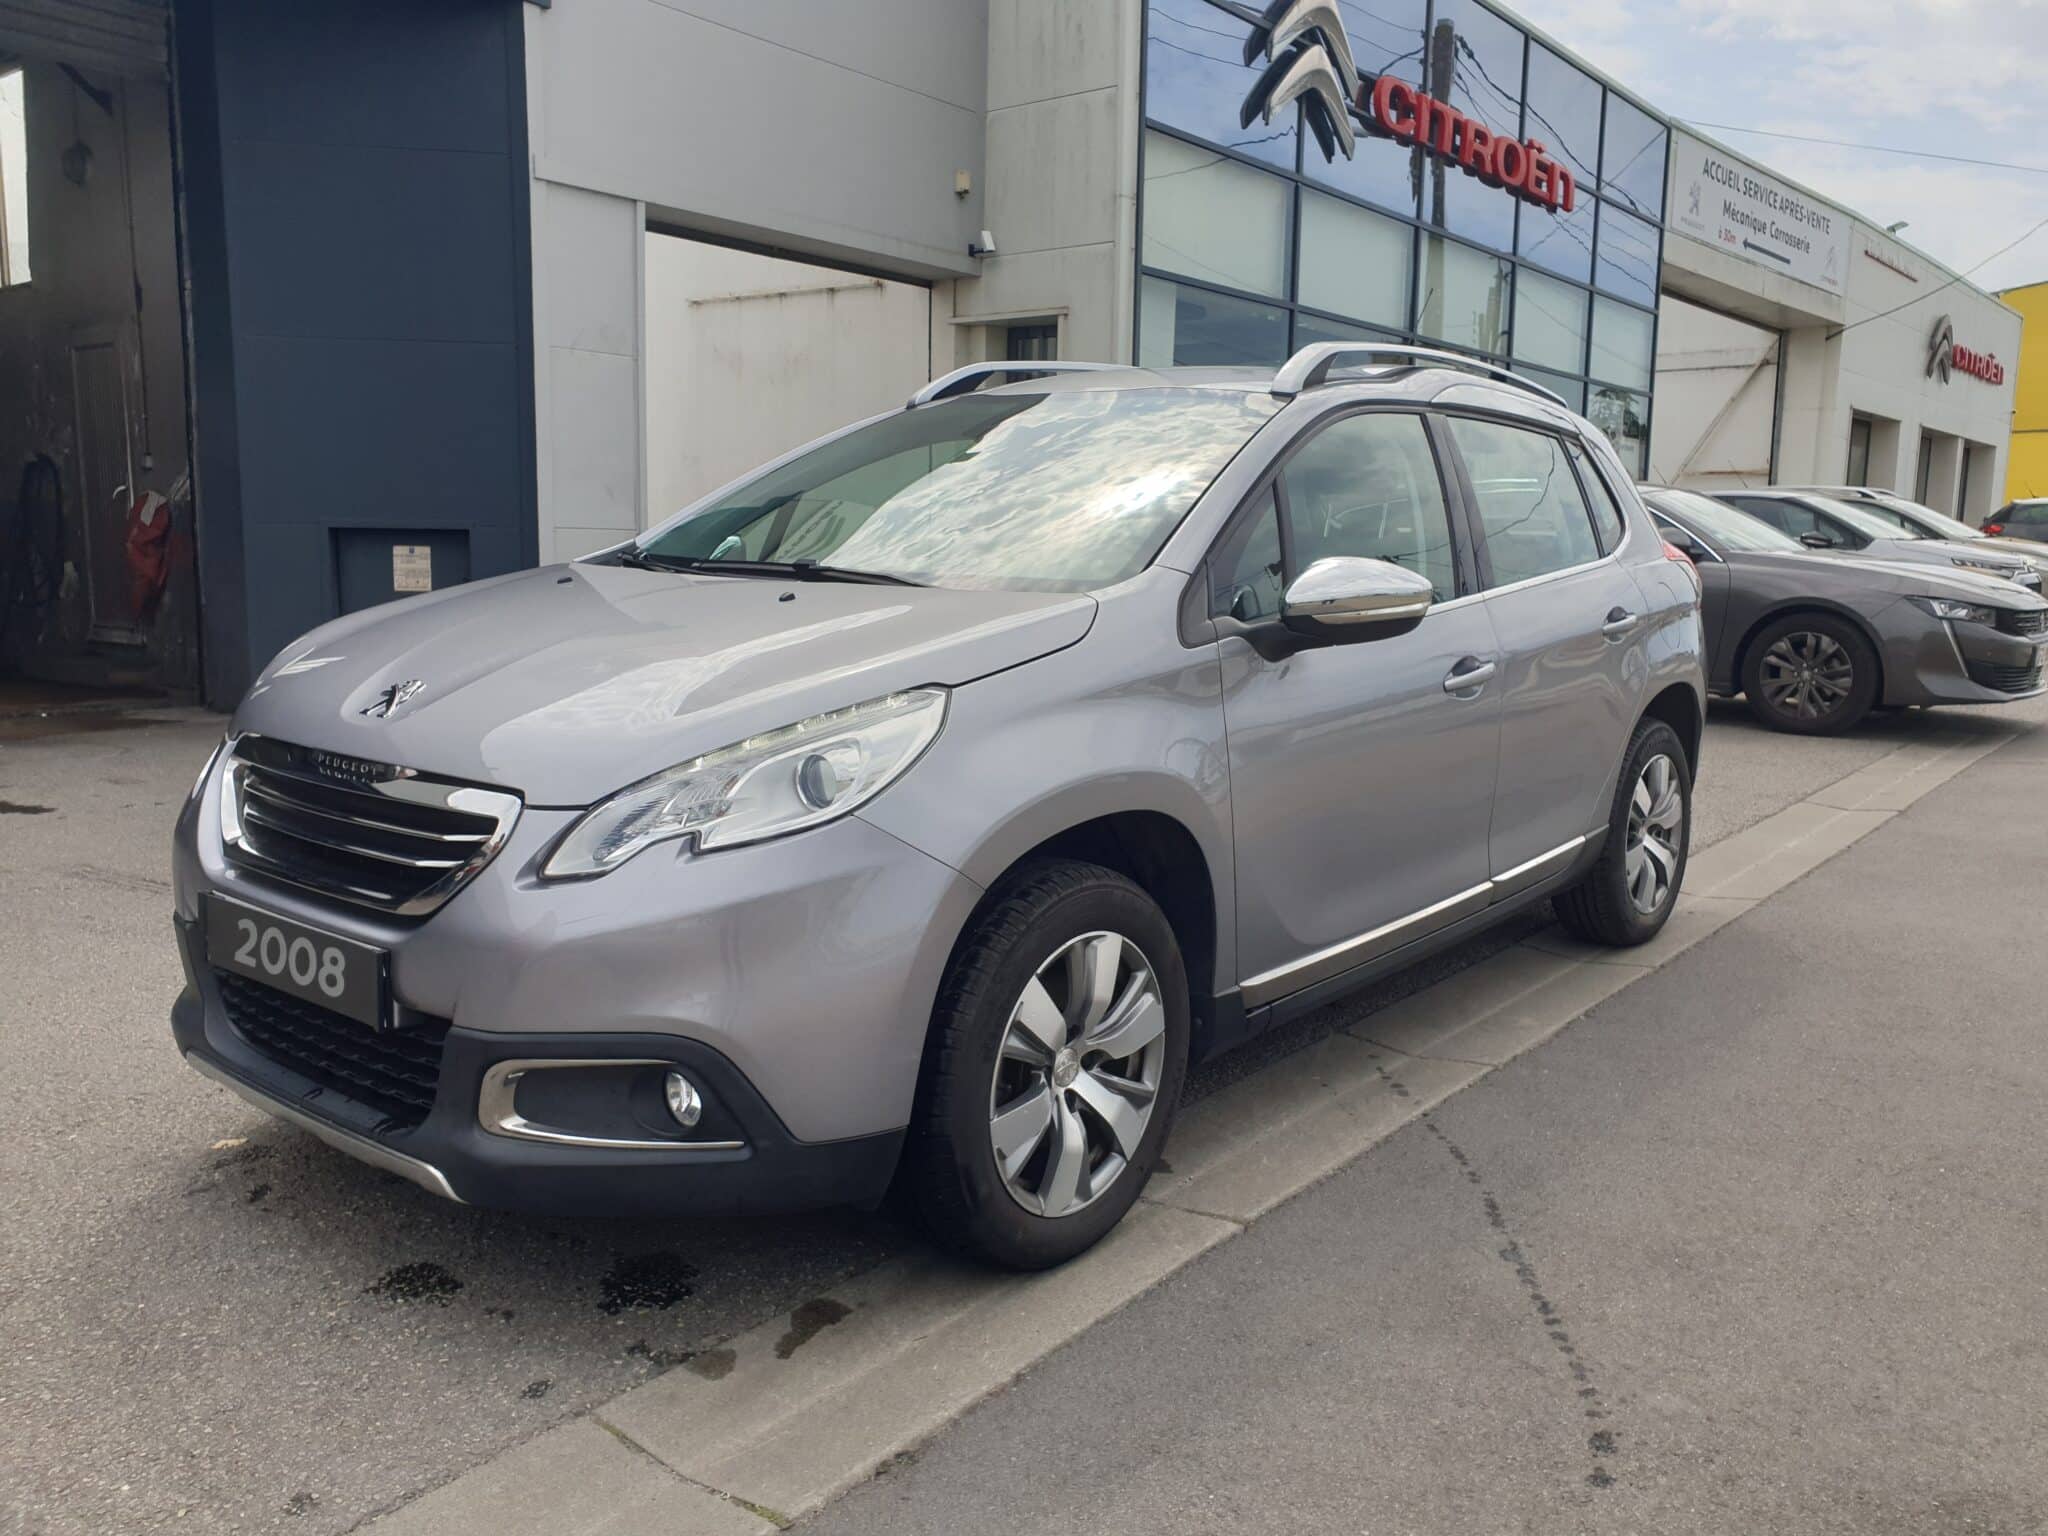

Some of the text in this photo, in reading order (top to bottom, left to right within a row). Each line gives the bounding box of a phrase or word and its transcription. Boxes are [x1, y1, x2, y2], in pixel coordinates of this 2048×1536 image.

[1703, 157, 1832, 236] ACCUEIL SERVICE APRÈS-VENTE
[1723, 199, 1767, 235] Mécanique
[1770, 221, 1810, 254] Carrosserie
[318, 752, 377, 776] PEUGEOT
[233, 918, 346, 998] 2008
